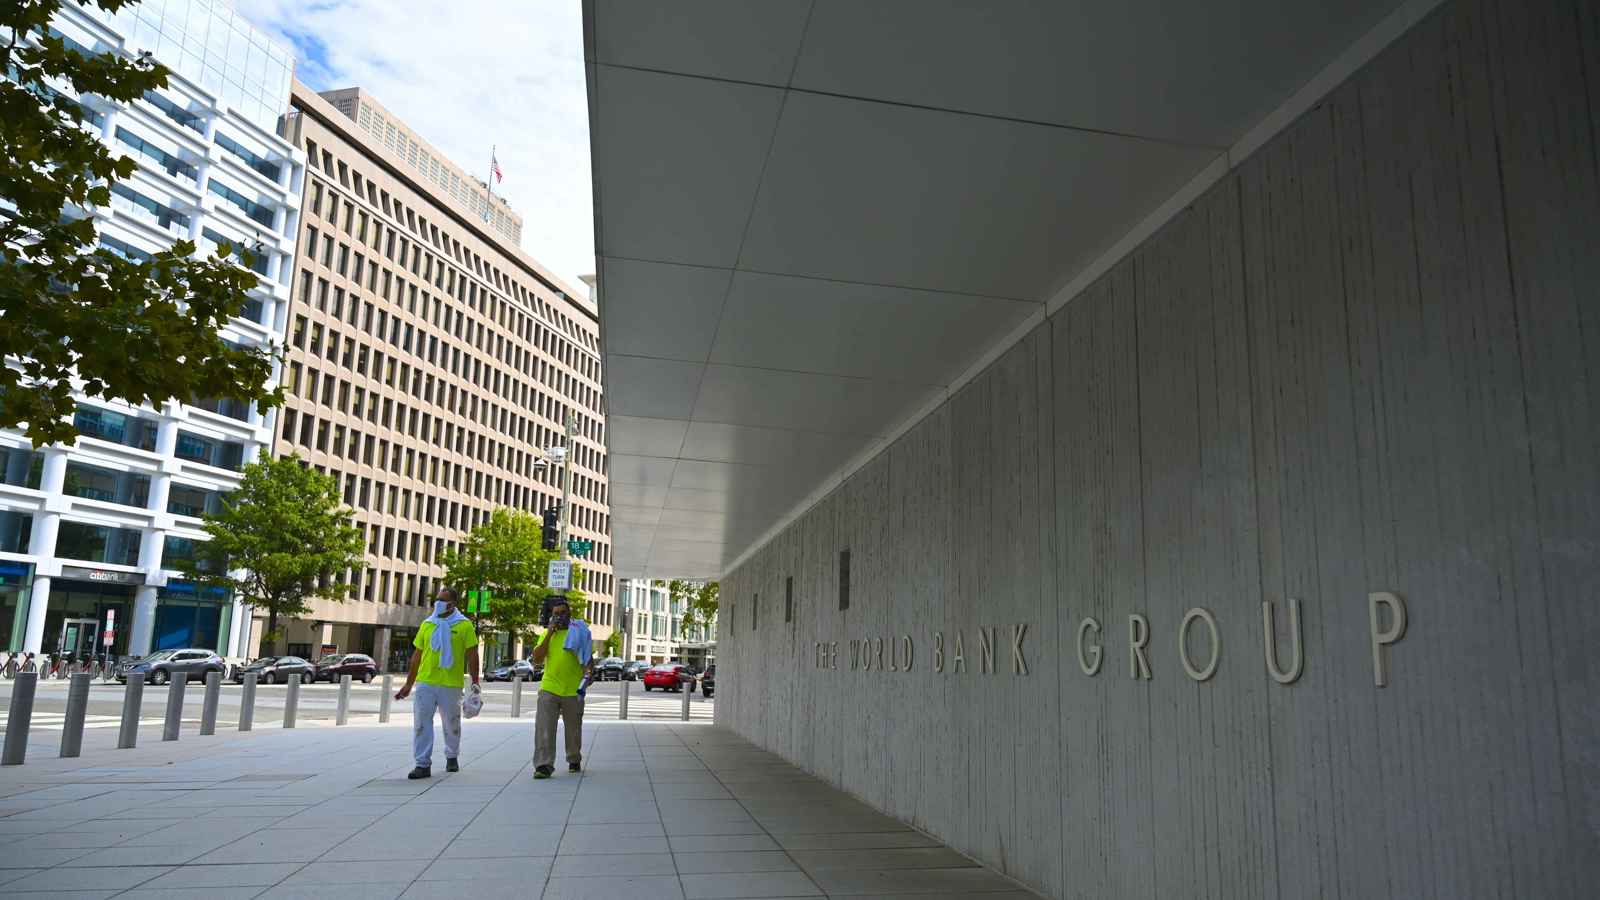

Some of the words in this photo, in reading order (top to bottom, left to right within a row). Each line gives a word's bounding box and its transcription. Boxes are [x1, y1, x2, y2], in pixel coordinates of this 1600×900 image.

[89, 570, 119, 583] citibank
[815, 641, 838, 670] THE
[849, 635, 914, 672] WORLD
[935, 624, 1029, 675] BANK
[1077, 591, 1407, 688] GROUP
